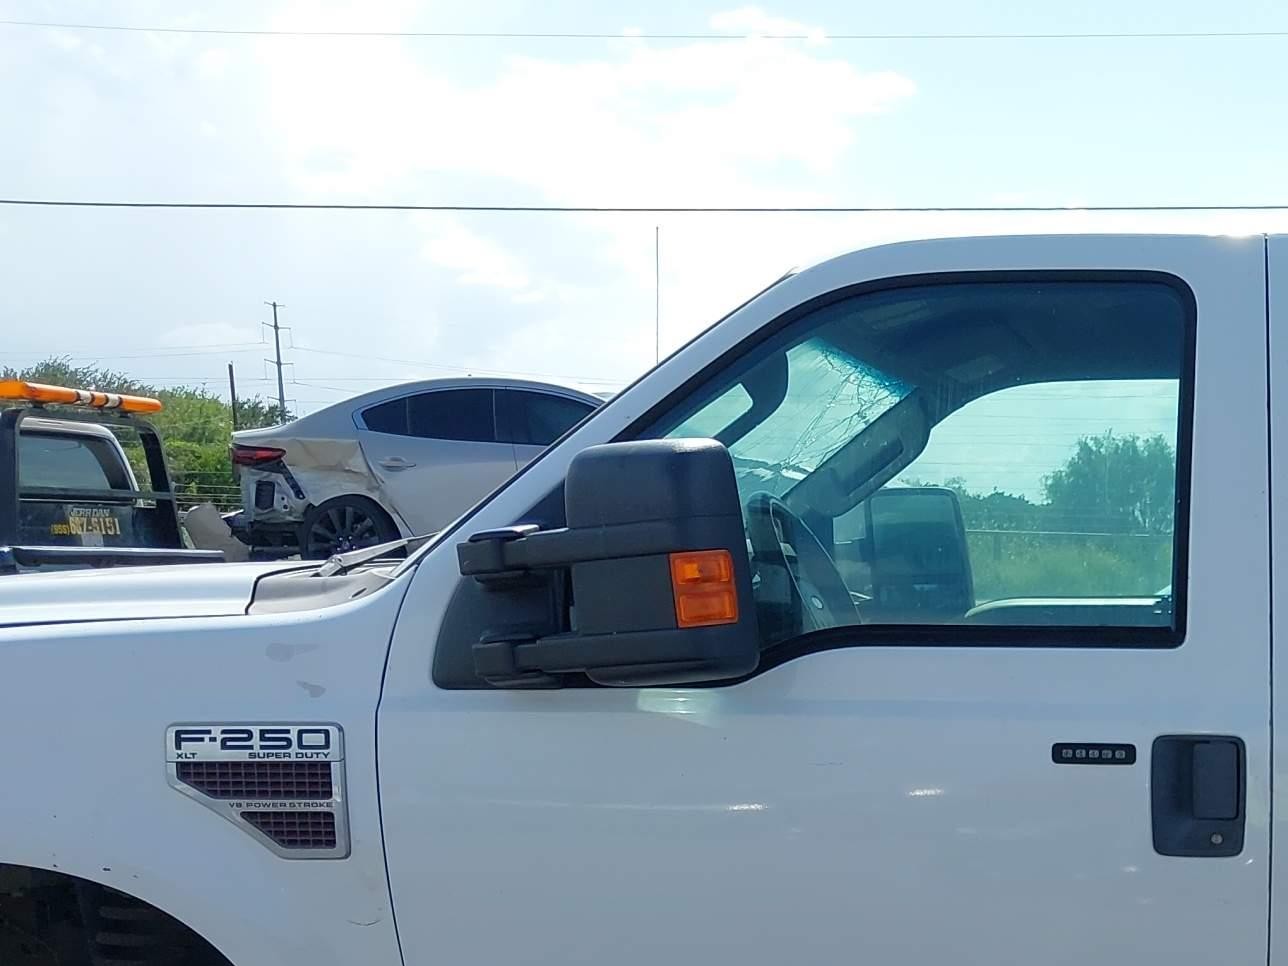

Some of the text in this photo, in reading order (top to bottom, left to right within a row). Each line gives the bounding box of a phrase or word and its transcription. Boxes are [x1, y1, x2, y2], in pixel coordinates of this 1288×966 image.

[174, 729, 331, 750] F-250
[175, 751, 331, 760] XLT SUPER DUTY
